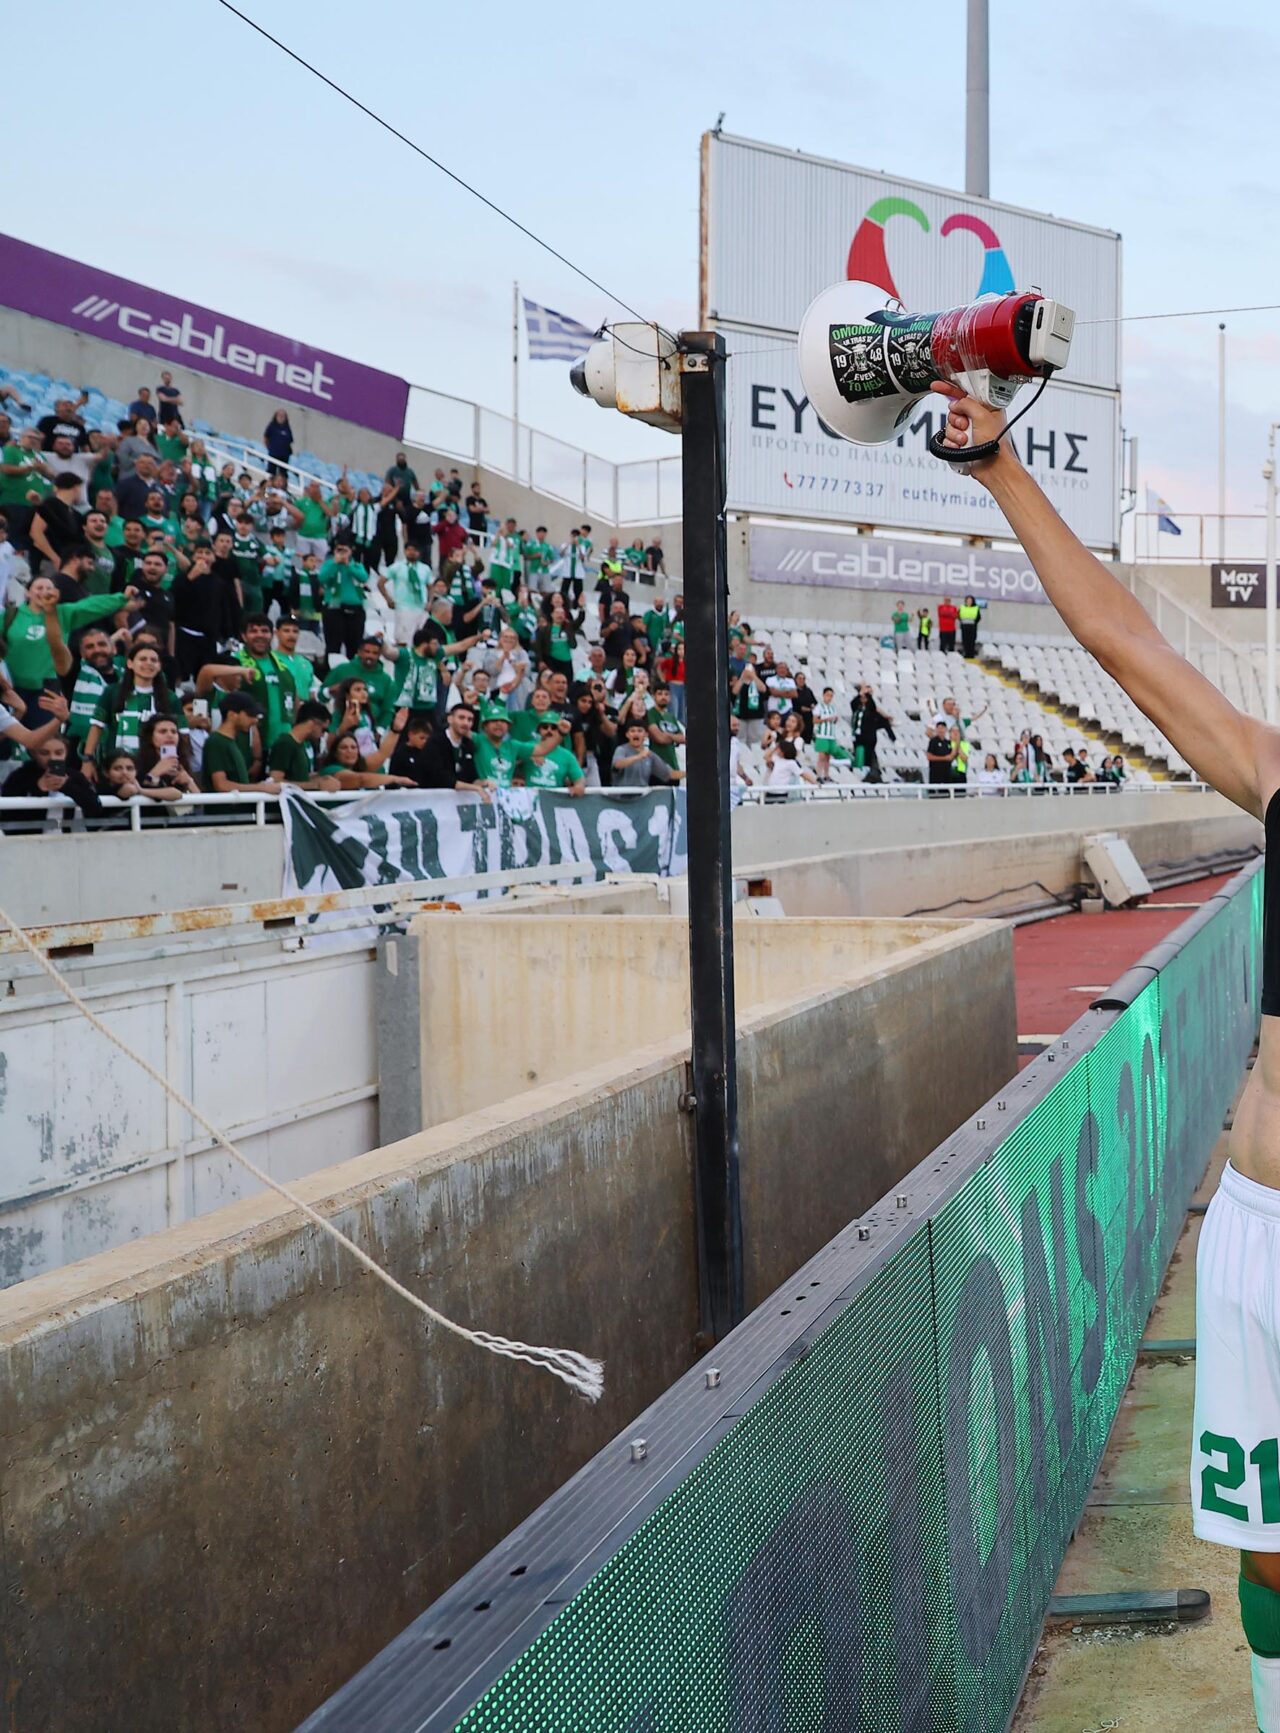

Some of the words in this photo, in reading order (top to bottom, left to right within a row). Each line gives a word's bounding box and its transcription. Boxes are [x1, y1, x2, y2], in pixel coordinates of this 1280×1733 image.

[118, 307, 335, 401] cablenet
[834, 355, 847, 368] 19
[870, 348, 883, 361] 48
[890, 352, 902, 366] 19
[854, 370, 876, 381] EVEN
[847, 381, 861, 391] TO
[752, 435, 840, 457] ΠΡΟΤΥΠΟ
[1220, 570, 1259, 586] Max
[1226, 587, 1253, 602] TV
